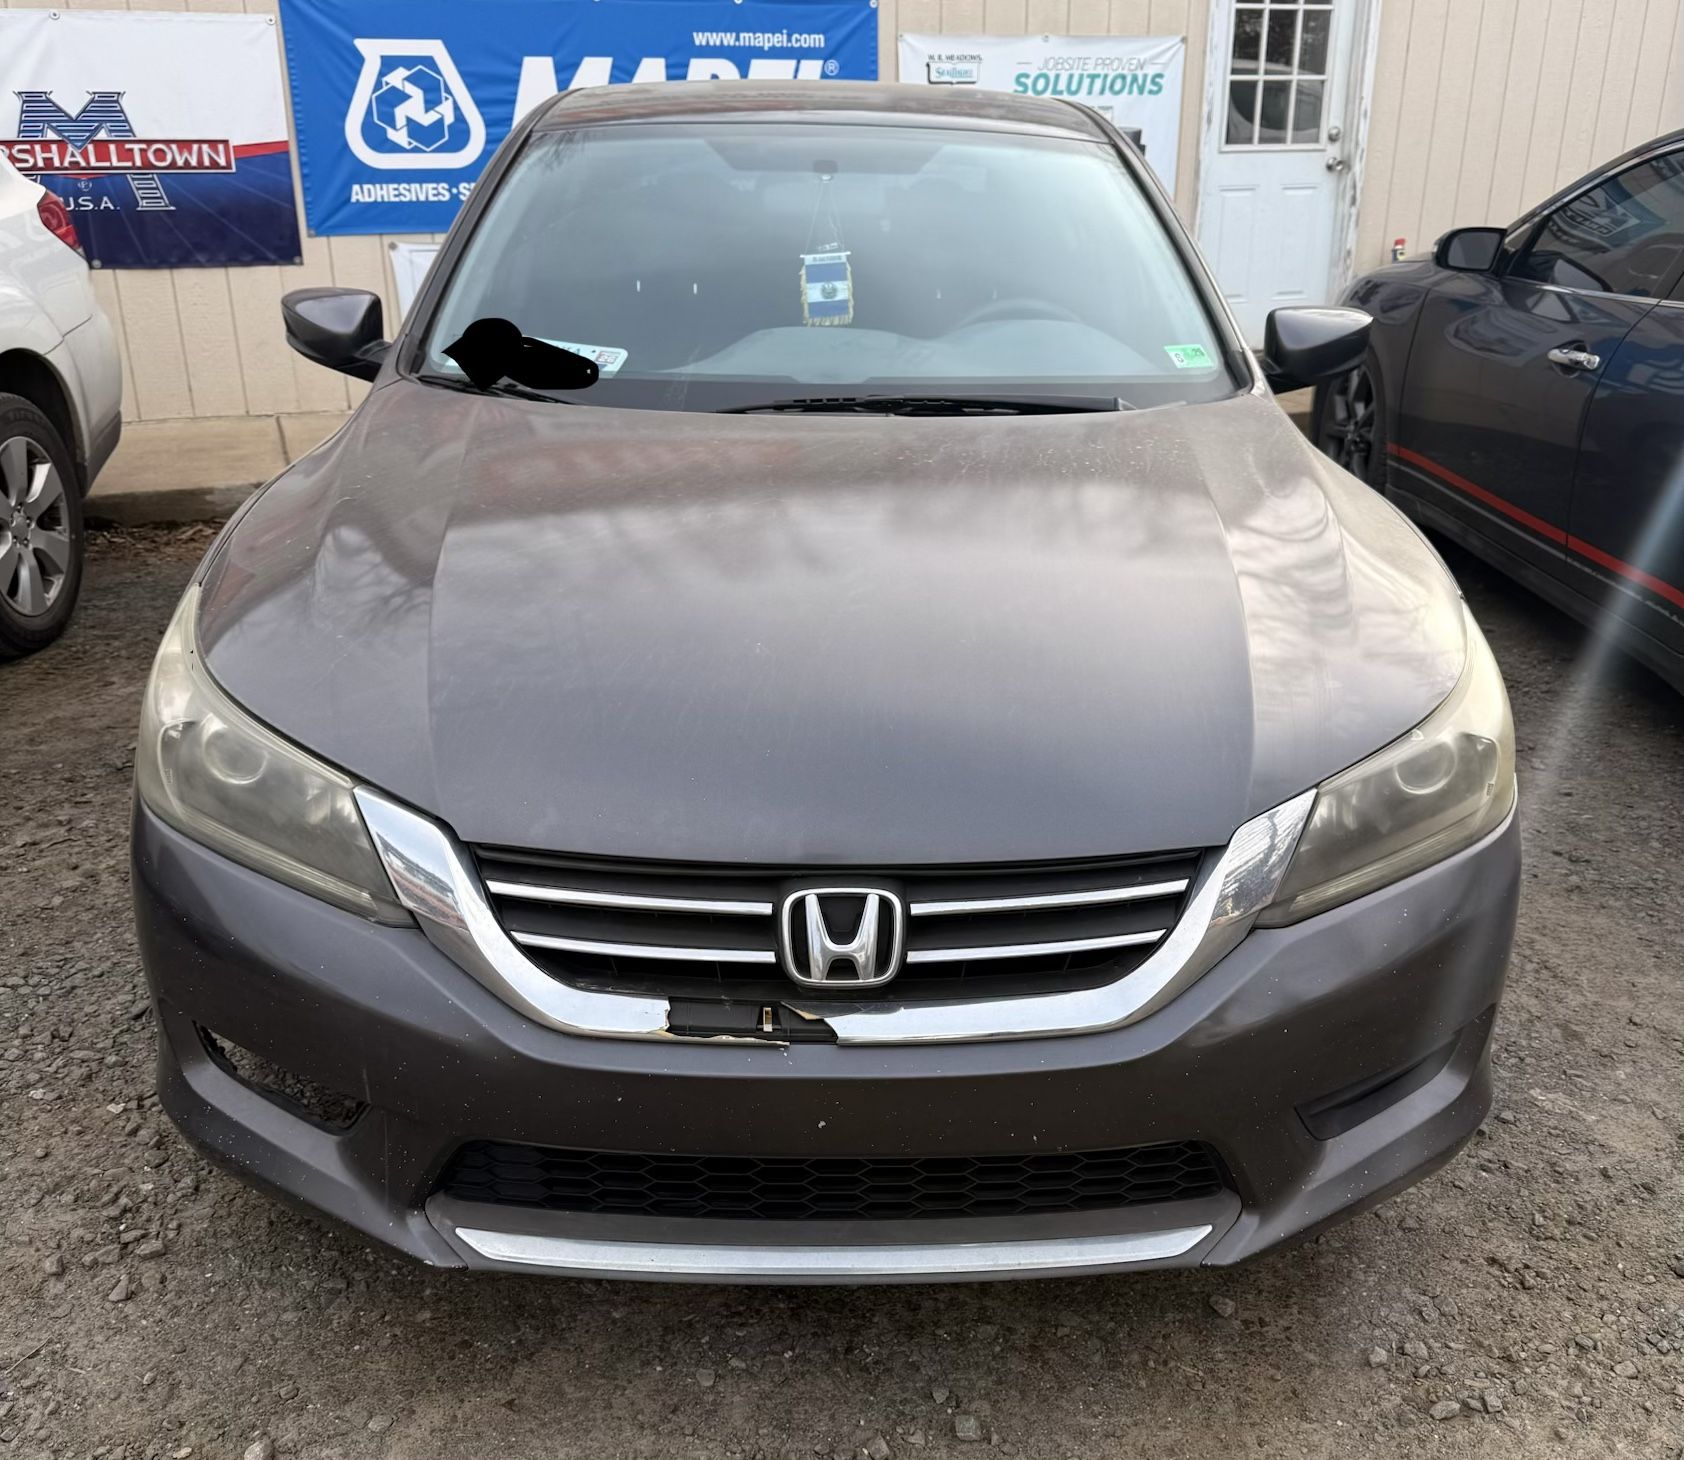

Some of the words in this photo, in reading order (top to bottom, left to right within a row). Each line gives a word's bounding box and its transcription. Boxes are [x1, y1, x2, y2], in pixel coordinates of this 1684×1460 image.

[693, 30, 825, 50] www.mapei.com
[1037, 57, 1091, 71] JOBSITE
[1095, 57, 1147, 71] PROVEN
[1013, 72, 1165, 96] SOLUTIONS
[351, 183, 450, 203] ADHESIVES
